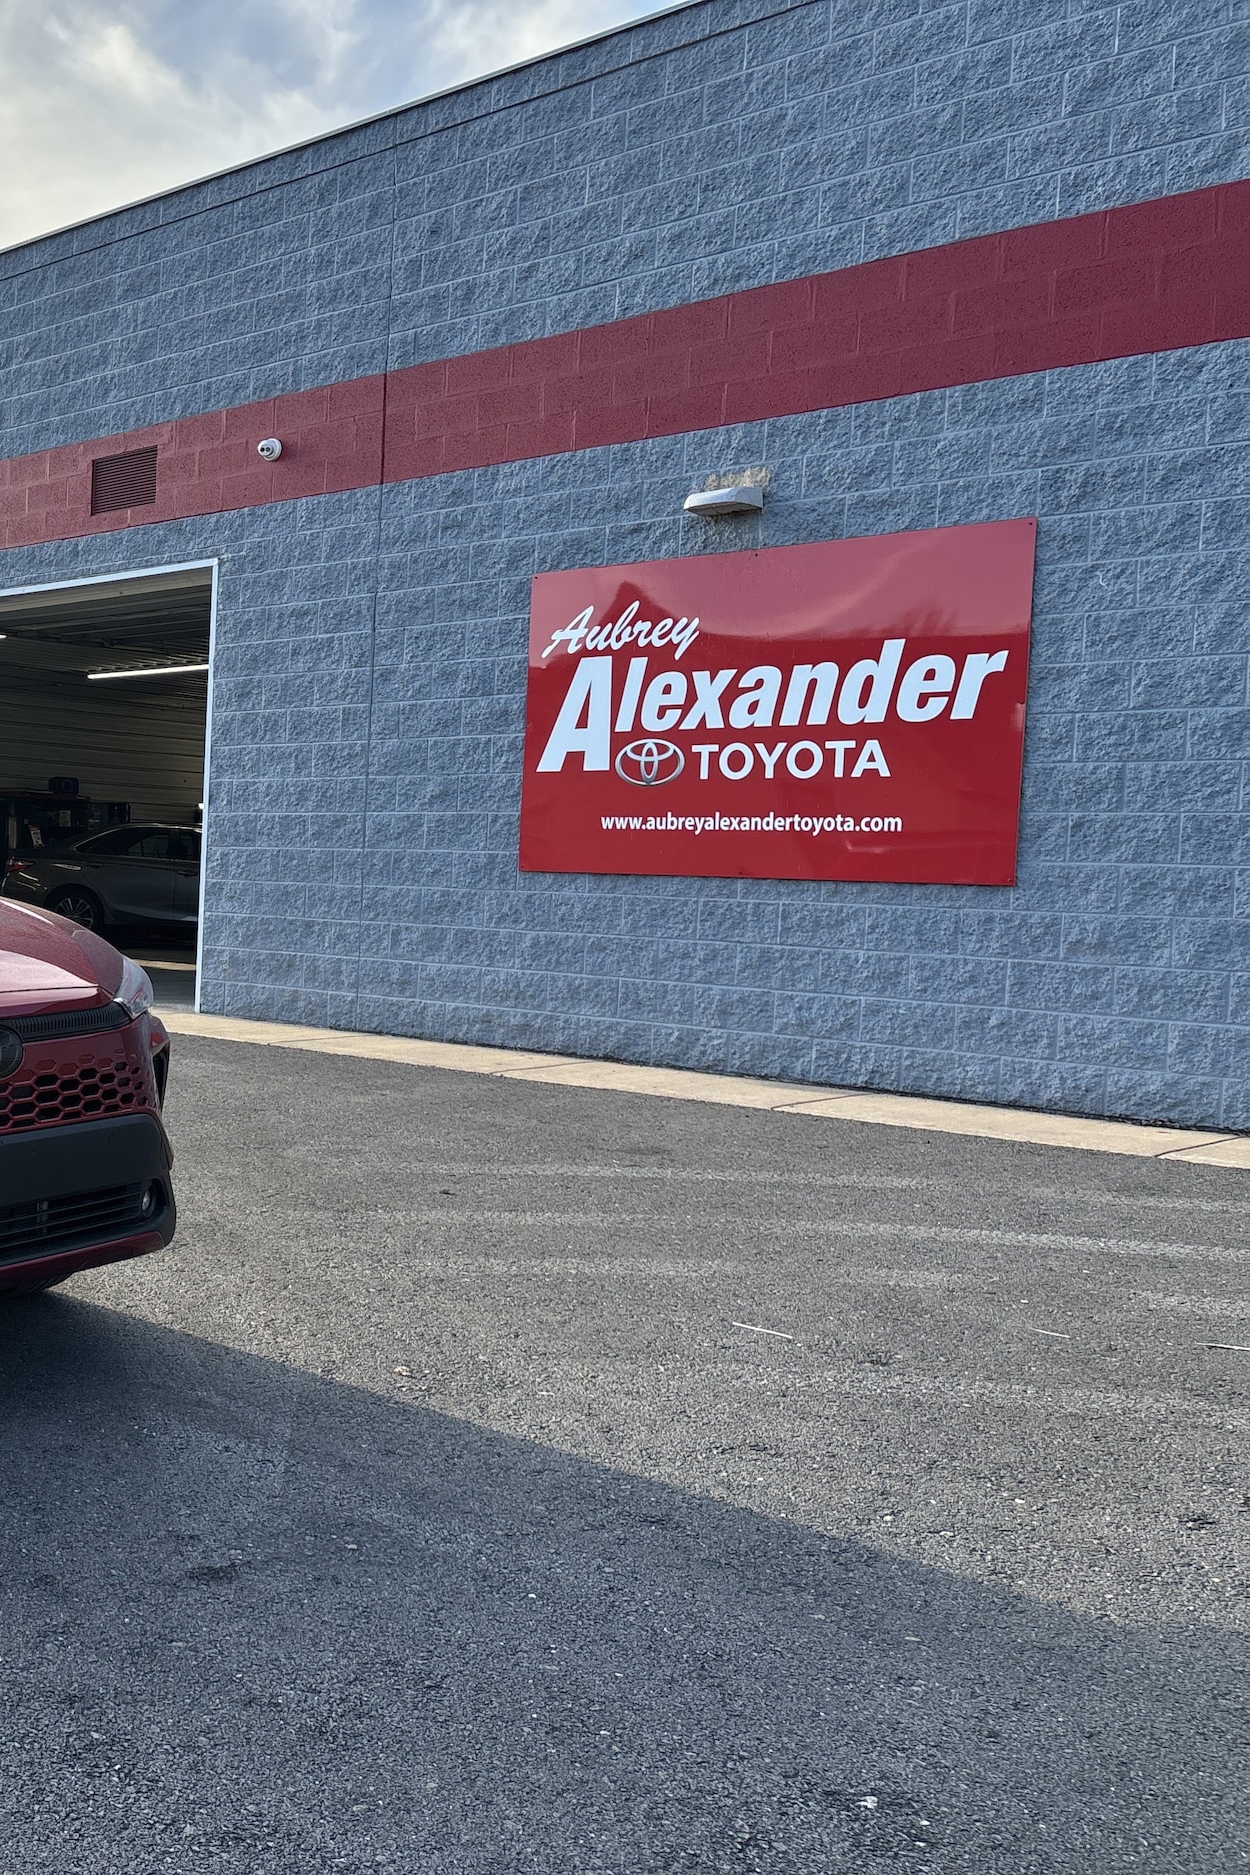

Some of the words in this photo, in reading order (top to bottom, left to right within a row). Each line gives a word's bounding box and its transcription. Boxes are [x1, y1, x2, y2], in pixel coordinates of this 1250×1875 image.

[541, 600, 700, 661] Aubrey
[536, 638, 1009, 773] Alexander
[691, 739, 891, 780] TOYOTA
[600, 811, 903, 837] www.aubreyalexandertoyota.com
